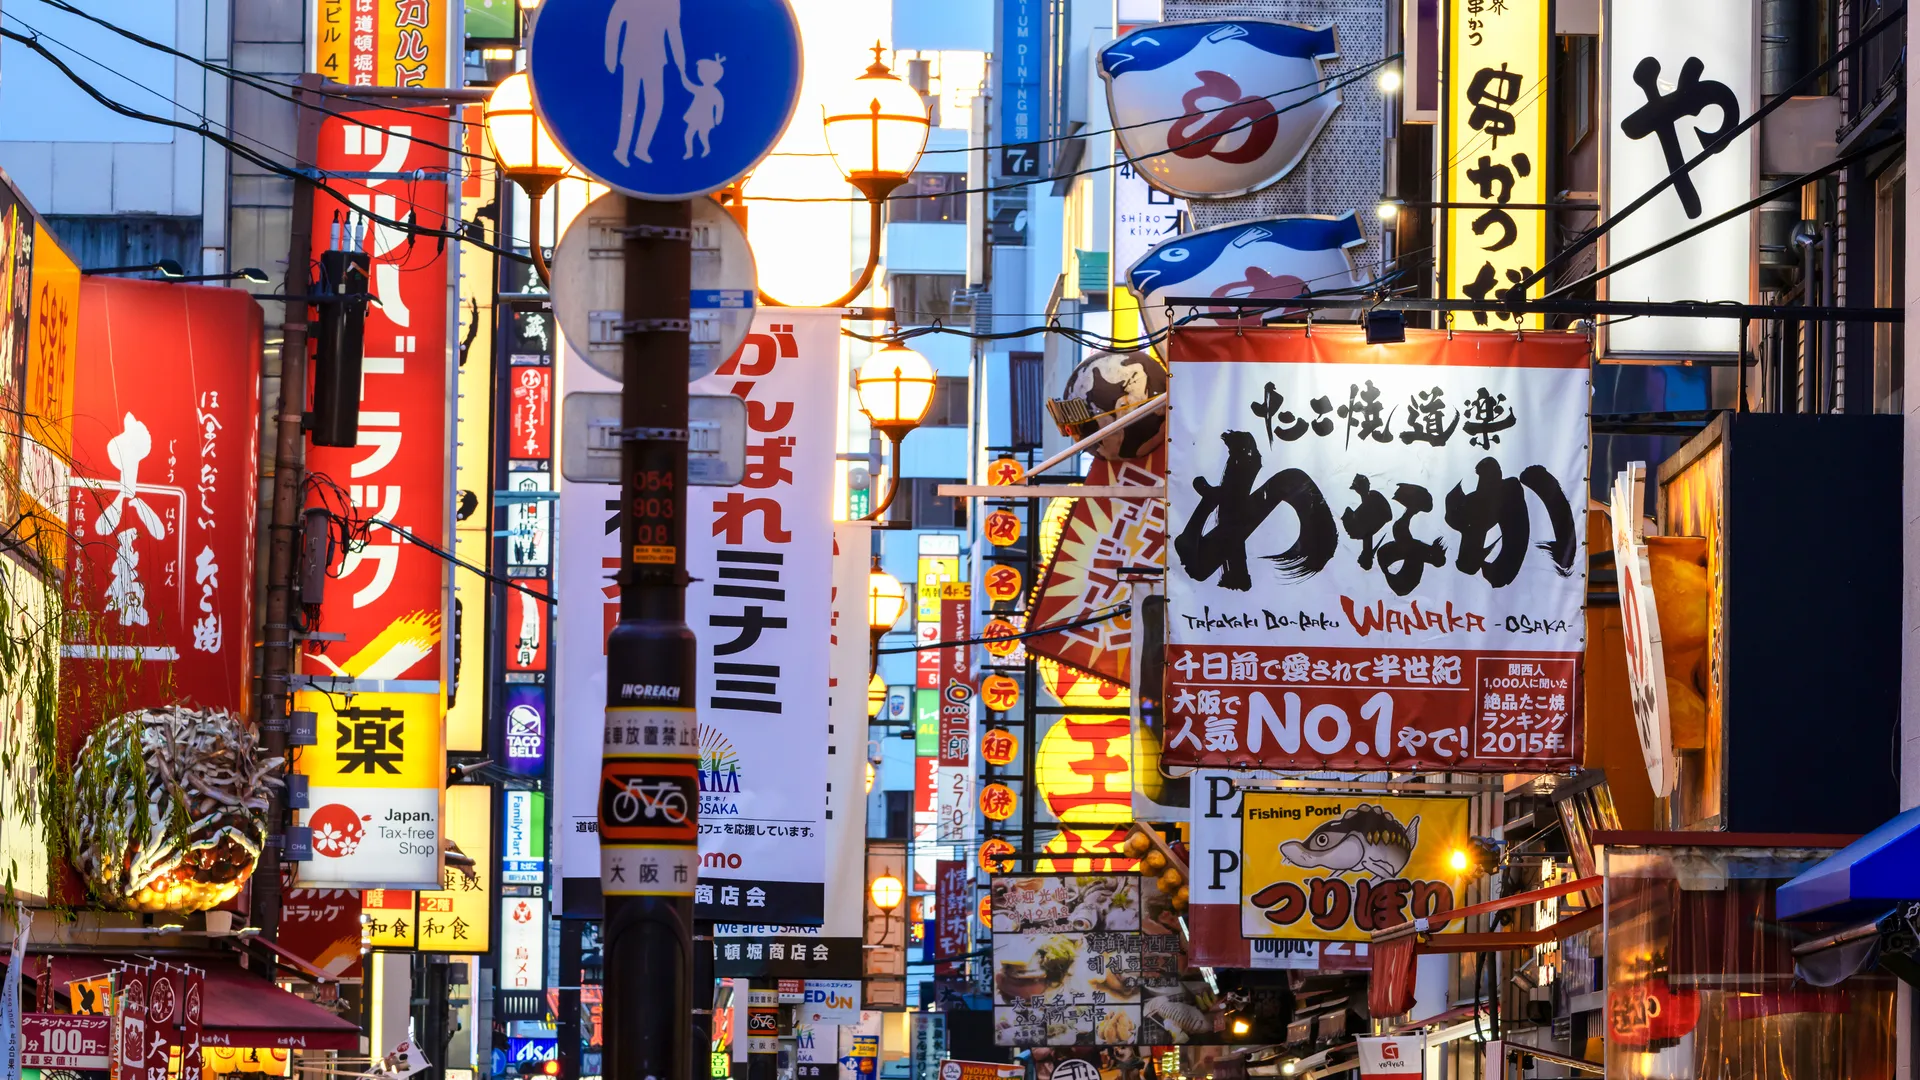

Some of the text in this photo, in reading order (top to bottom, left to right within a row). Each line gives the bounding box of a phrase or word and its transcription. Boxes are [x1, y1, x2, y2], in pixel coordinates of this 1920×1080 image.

[1467, 0, 1484, 46] 串かつ
[1017, 44, 1028, 110] DINING
[1621, 56, 1740, 220] や
[1007, 149, 1034, 173] 7F
[543, 249, 551, 259] 6
[542, 355, 550, 365] 5
[1251, 379, 1517, 451] たこ焼道楽
[541, 461, 549, 470] 4
[634, 471, 673, 491] 054
[633, 498, 674, 518] 903
[1174, 429, 1578, 597] わなか
[165, 508, 176, 535] はち
[165, 560, 176, 587] ばん
[538, 567, 547, 577] 3
[193, 545, 222, 653] たこ焼
[536, 673, 545, 683] 2
[1174, 651, 1462, 685] 千日前で愛されて半世紀
[1508, 663, 1545, 676] 関西人
[1483, 678, 1568, 690] 1,000人に聞いた
[1172, 690, 1241, 716] 大阪で
[1484, 693, 1566, 711] 絶品たこ焼
[1247, 691, 1394, 758] No.1
[1482, 711, 1568, 731] ランキング
[336, 706, 405, 774] 薬
[506, 736, 541, 747] TACO
[1170, 717, 1238, 751] 人気
[1398, 726, 1470, 758] やで!
[1481, 731, 1566, 754] 2015年
[508, 746, 541, 758] BELL
[952, 773, 969, 839] 270円
[1249, 804, 1341, 820] Fishing Pond
[384, 808, 435, 825] Japan.
[513, 795, 523, 856] FamilyMart
[378, 825, 435, 840] Tax-free
[399, 841, 435, 858] Shop
[698, 852, 742, 869] mo
[610, 864, 688, 884] 大阪市
[366, 889, 384, 907] 階
[533, 886, 543, 896] B
[695, 884, 766, 908] 商店会
[1008, 906, 1071, 924] 어서오세요
[1251, 877, 1454, 934] つりぼり
[368, 917, 410, 939] 和食
[422, 916, 470, 941] 和食
[804, 989, 853, 1009] EDION
[516, 1040, 559, 1062] Asa
[963, 1066, 997, 1076] INDIAN
